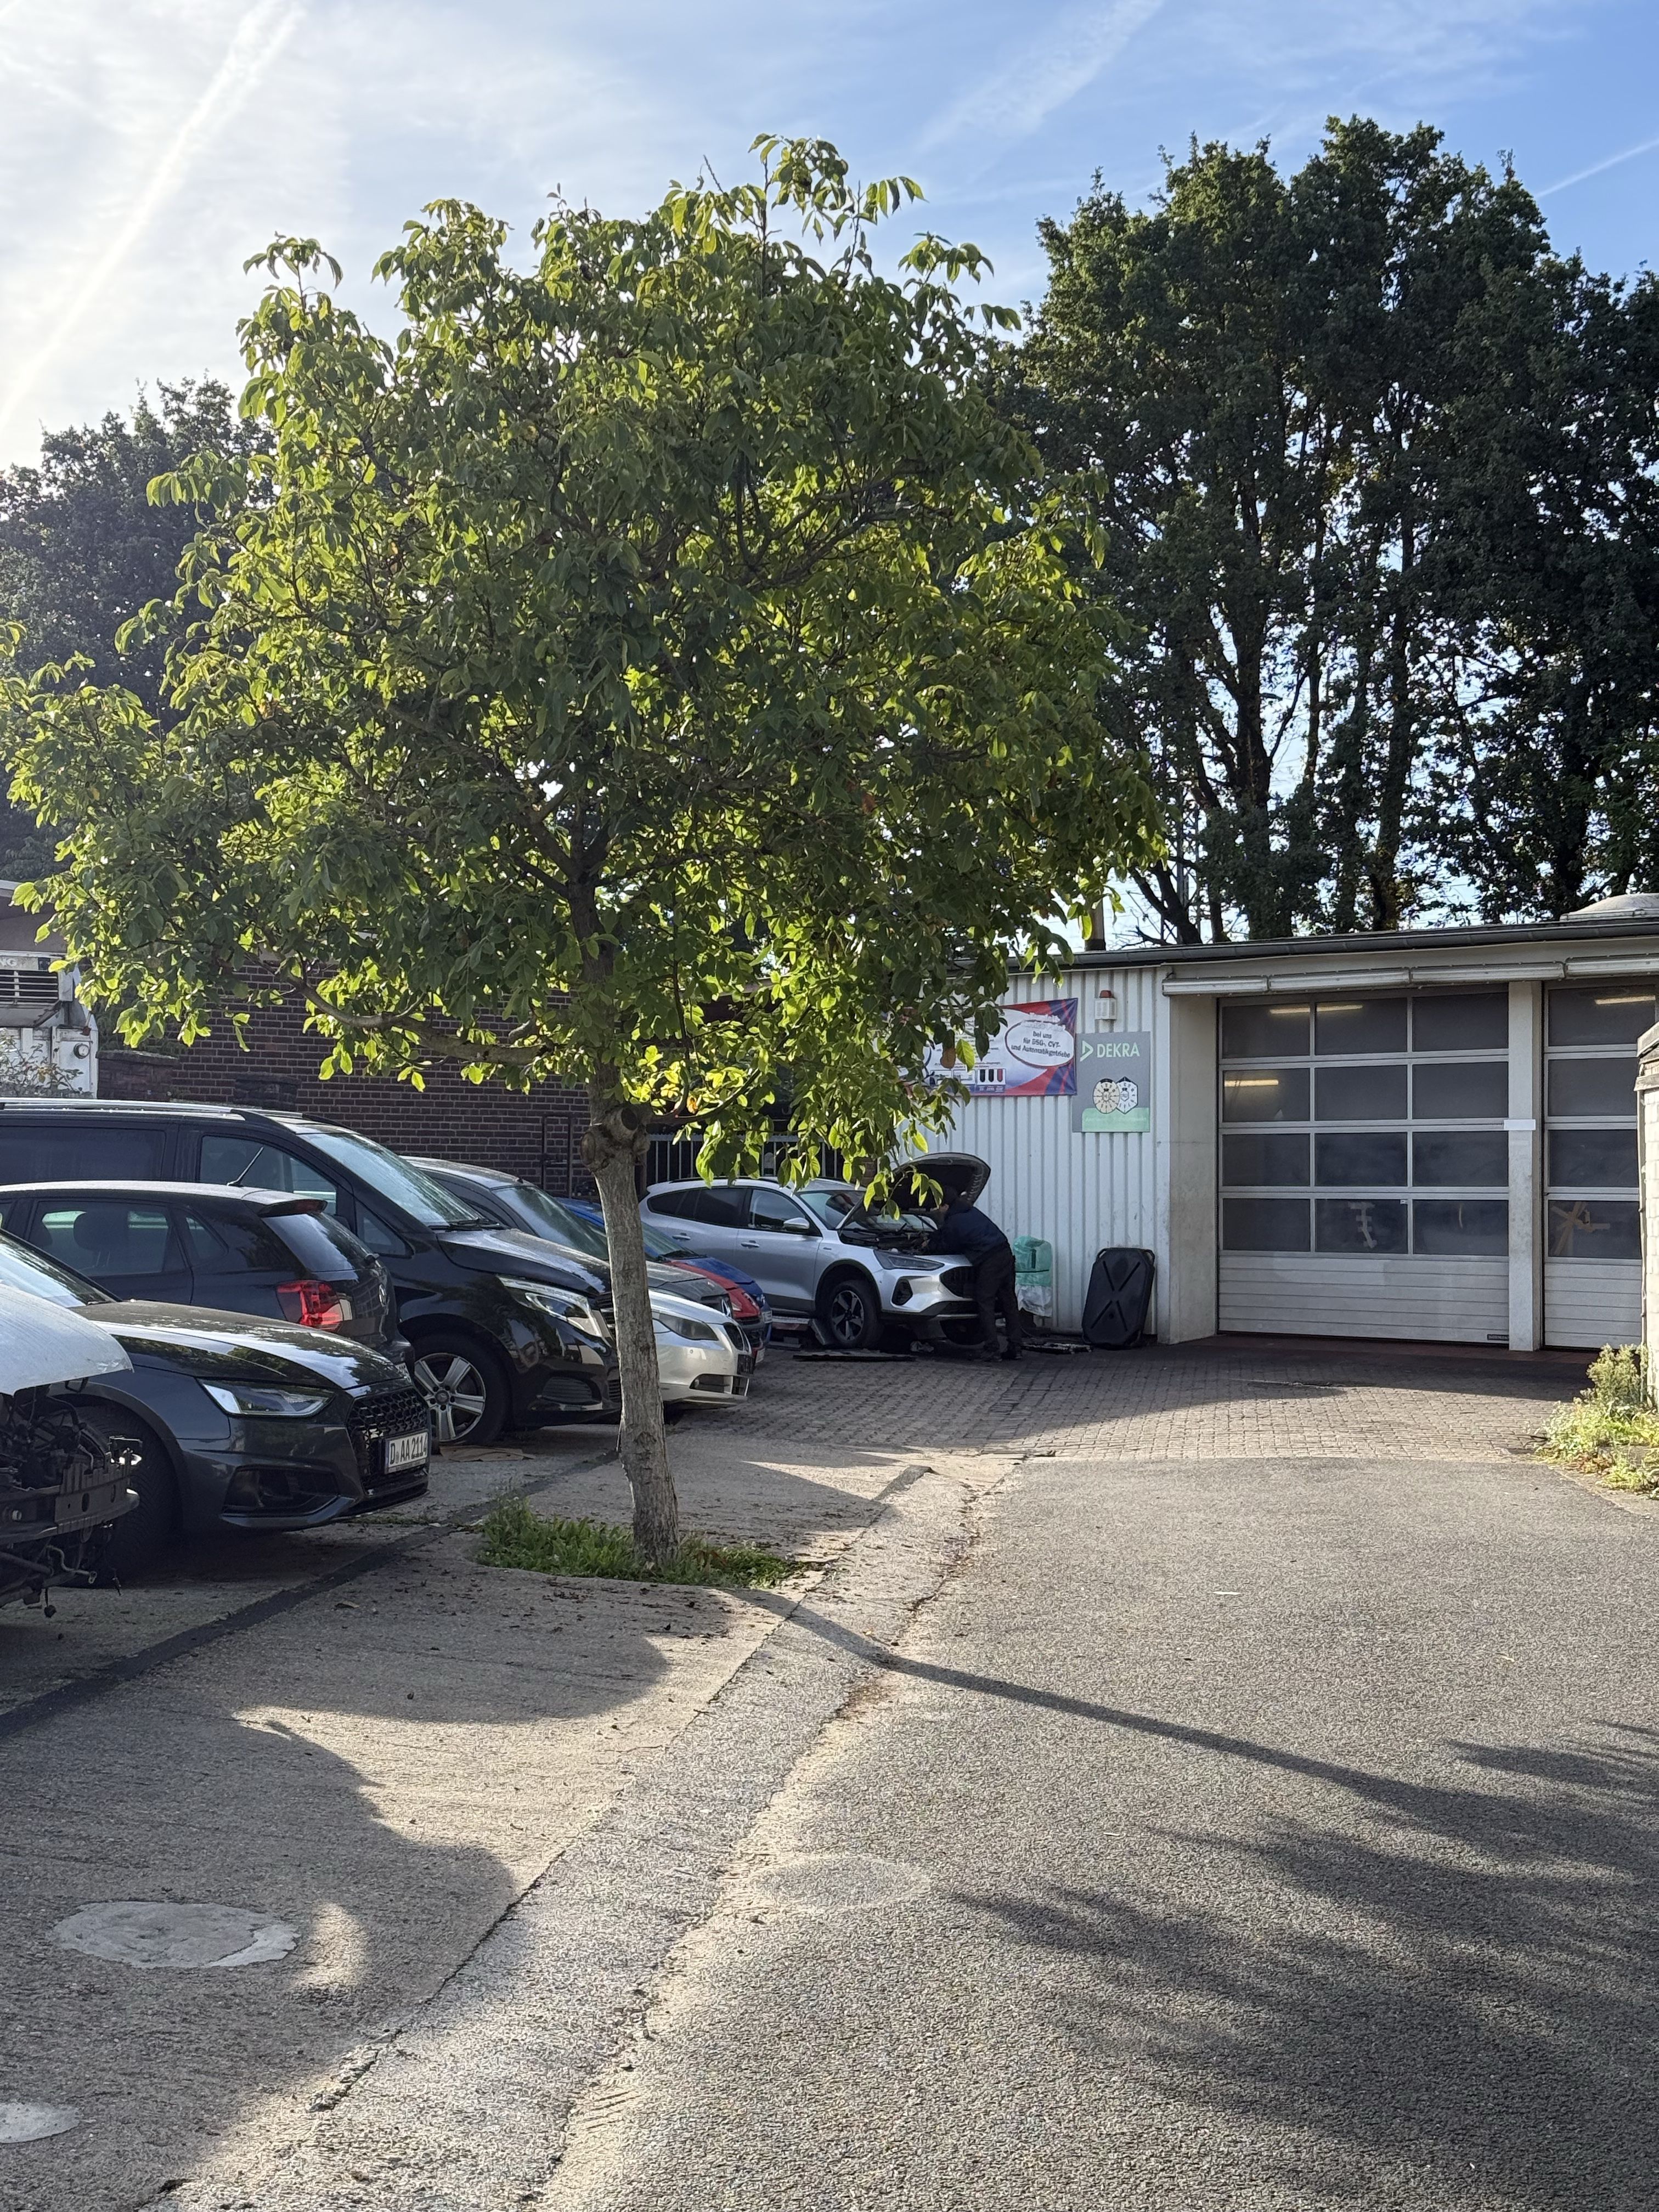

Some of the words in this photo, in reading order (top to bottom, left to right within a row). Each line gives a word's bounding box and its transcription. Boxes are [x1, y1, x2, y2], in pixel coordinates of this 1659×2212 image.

[1097, 1042, 1140, 1058] DEKRA
[390, 1443, 396, 1465] D
[400, 1439, 410, 1462] AA
